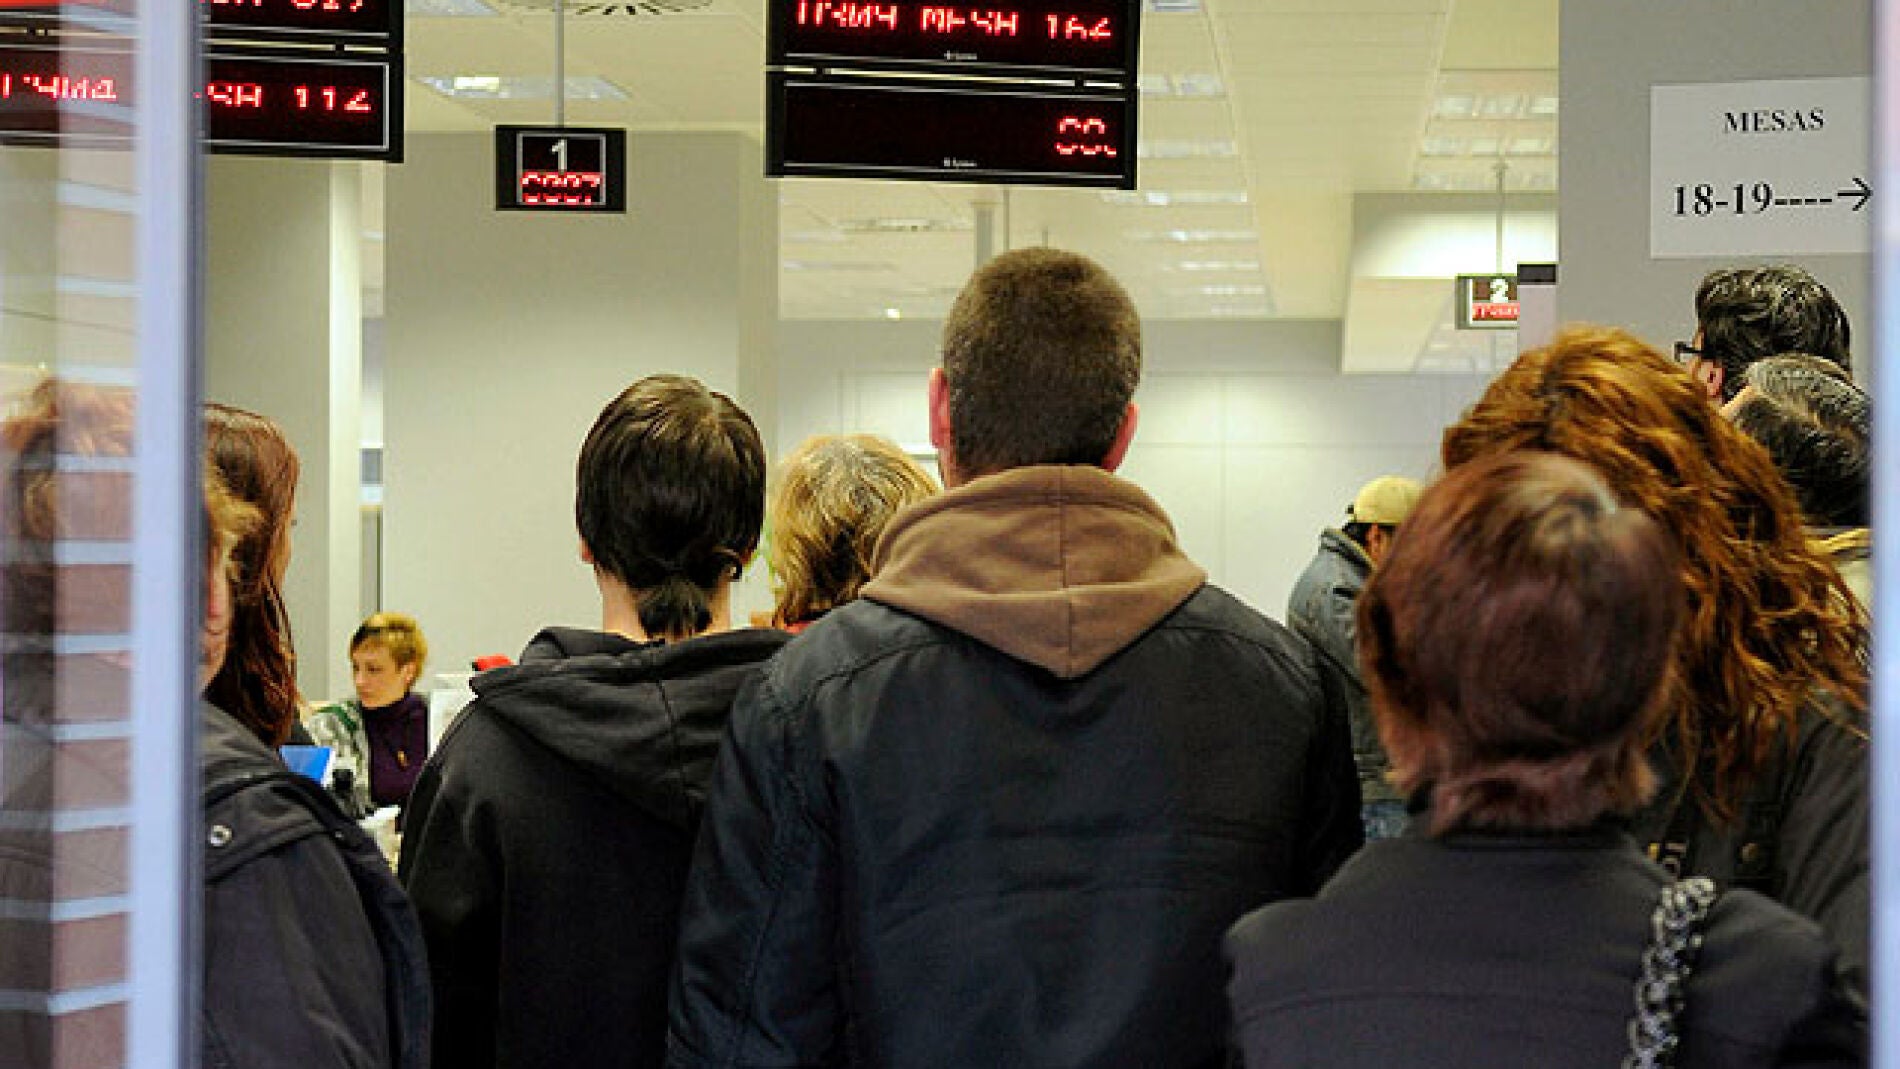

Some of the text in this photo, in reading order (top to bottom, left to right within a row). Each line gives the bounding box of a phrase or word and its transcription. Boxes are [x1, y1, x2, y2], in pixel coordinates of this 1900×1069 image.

[1723, 107, 1825, 134] MESAS
[551, 139, 567, 173] 1
[1490, 279, 1509, 303] 2
